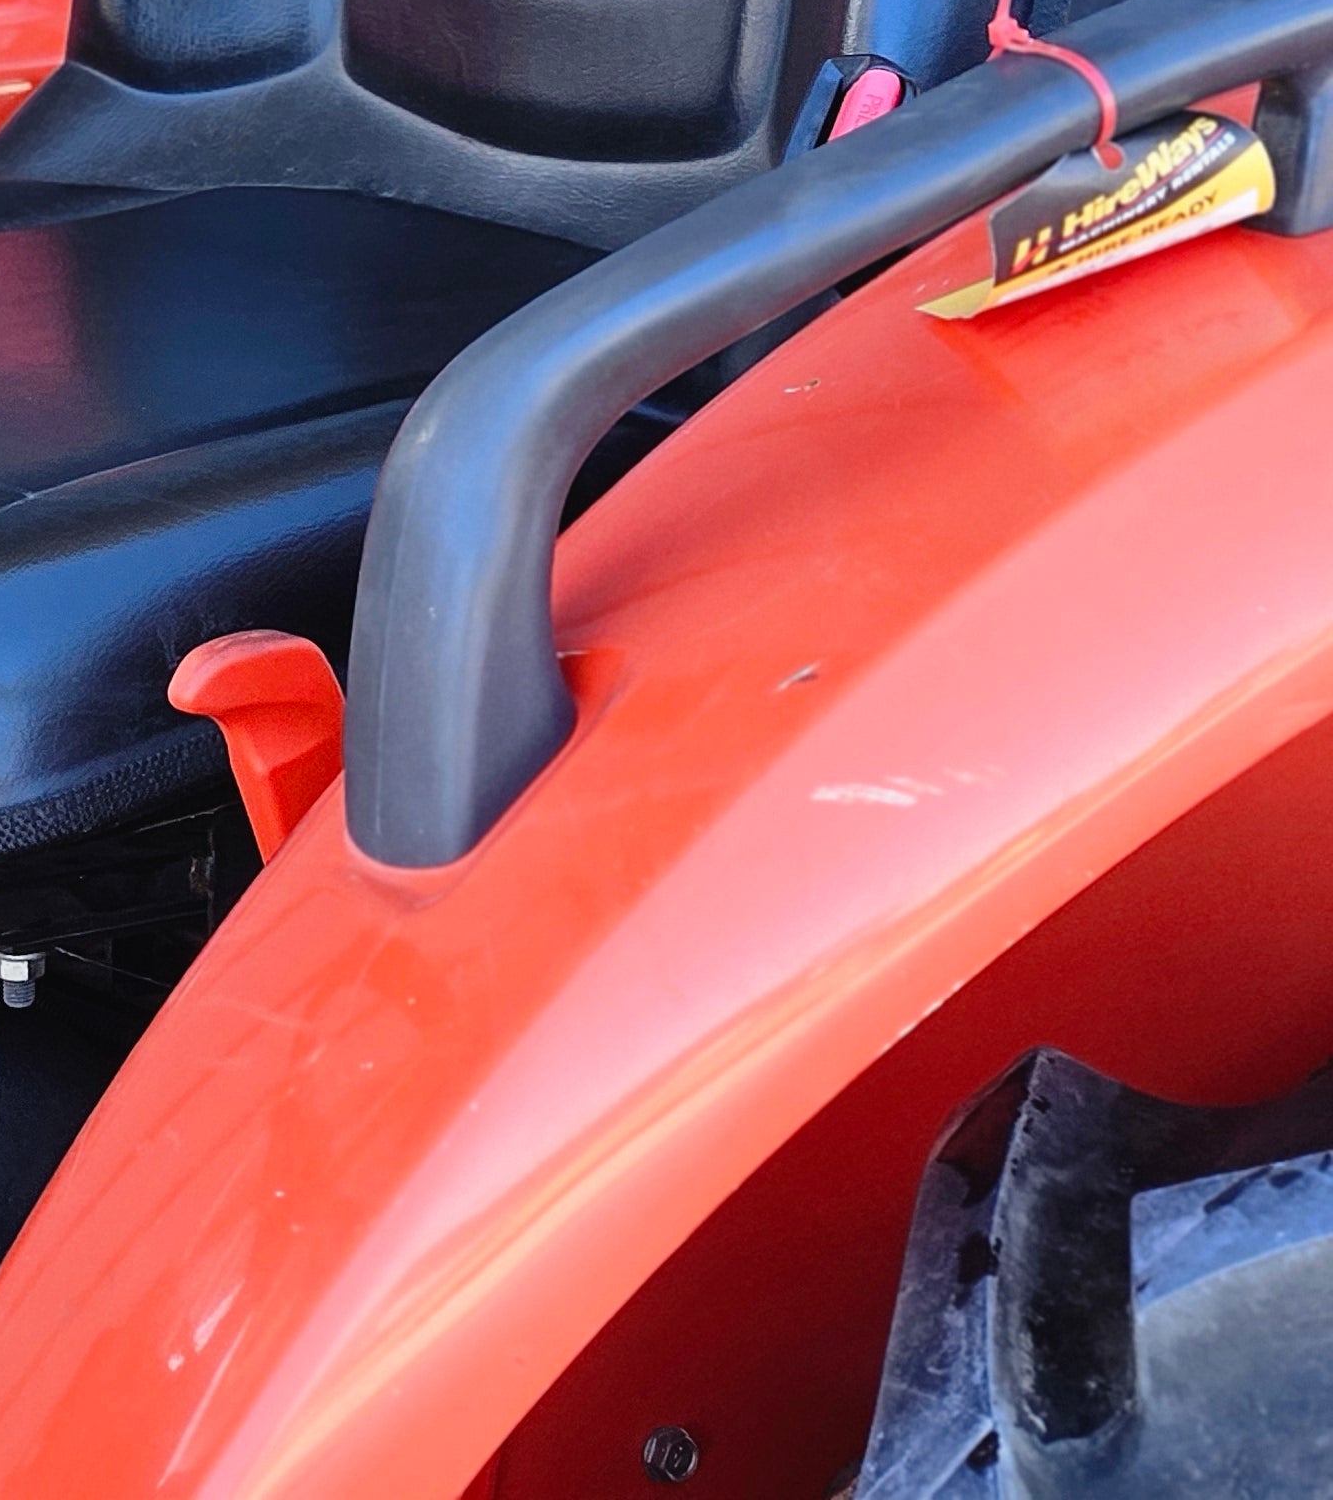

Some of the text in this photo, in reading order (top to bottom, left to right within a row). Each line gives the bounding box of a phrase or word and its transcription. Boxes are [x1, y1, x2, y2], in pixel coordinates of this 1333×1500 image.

[1058, 131, 1236, 253] MACHINERY RENTALS
[1062, 116, 1218, 238] HireWays
